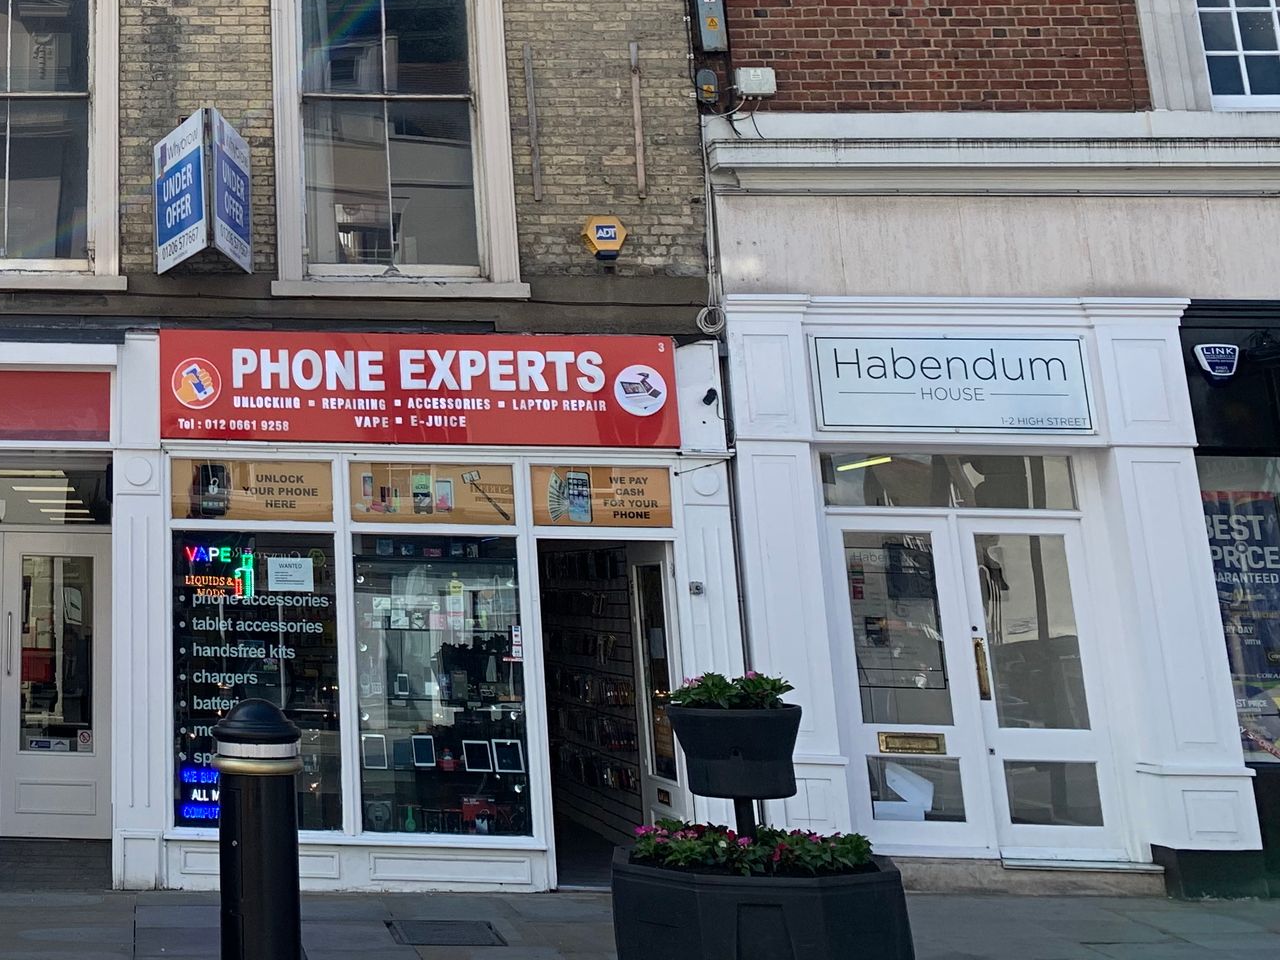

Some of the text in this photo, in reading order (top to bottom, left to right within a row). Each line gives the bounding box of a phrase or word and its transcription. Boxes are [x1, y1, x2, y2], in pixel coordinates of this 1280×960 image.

[163, 162, 193, 202] UNDER
[222, 159, 245, 202] UNDER
[165, 192, 192, 229] OFFER
[224, 191, 244, 228] OFFER
[596, 227, 617, 238] ADT
[162, 239, 178, 260] 01206
[657, 342, 665, 353] 3
[1203, 347, 1234, 355] LINK
[231, 348, 606, 393] PHONE EXPERTS
[833, 347, 1068, 381] Habendum
[920, 387, 985, 401] HOUSE
[233, 396, 607, 412] UNLOCKING REPAIRING ACCESSORIES LAPTOP REPAIR
[178, 418, 195, 430] Tel
[204, 419, 226, 430] 012
[229, 420, 257, 431] 0661
[261, 420, 289, 432] 9258
[354, 415, 467, 428] VAPE E-JUICE
[1001, 417, 1087, 427] 1-2 HIGH STREET
[256, 475, 304, 484] UNLOCK
[609, 476, 648, 485] WE PAY
[242, 486, 319, 497] YOUR PHONE
[615, 488, 645, 496] CASH
[265, 499, 296, 509] HERE
[604, 499, 658, 508] FOR YOUR
[613, 510, 651, 519] PHONE
[1204, 514, 1265, 541] BEST
[185, 546, 232, 562] VAPE
[185, 575, 226, 586] LIQUIDS
[1216, 572, 1279, 584] ARANTEED
[192, 592, 329, 608] phone accessories
[192, 616, 324, 633] tablet accessories
[193, 642, 295, 659] handsfree kits
[193, 669, 258, 687] chargers
[193, 695, 239, 710] batteri
[191, 789, 209, 801] ALL
[183, 806, 219, 819] COMPUT
